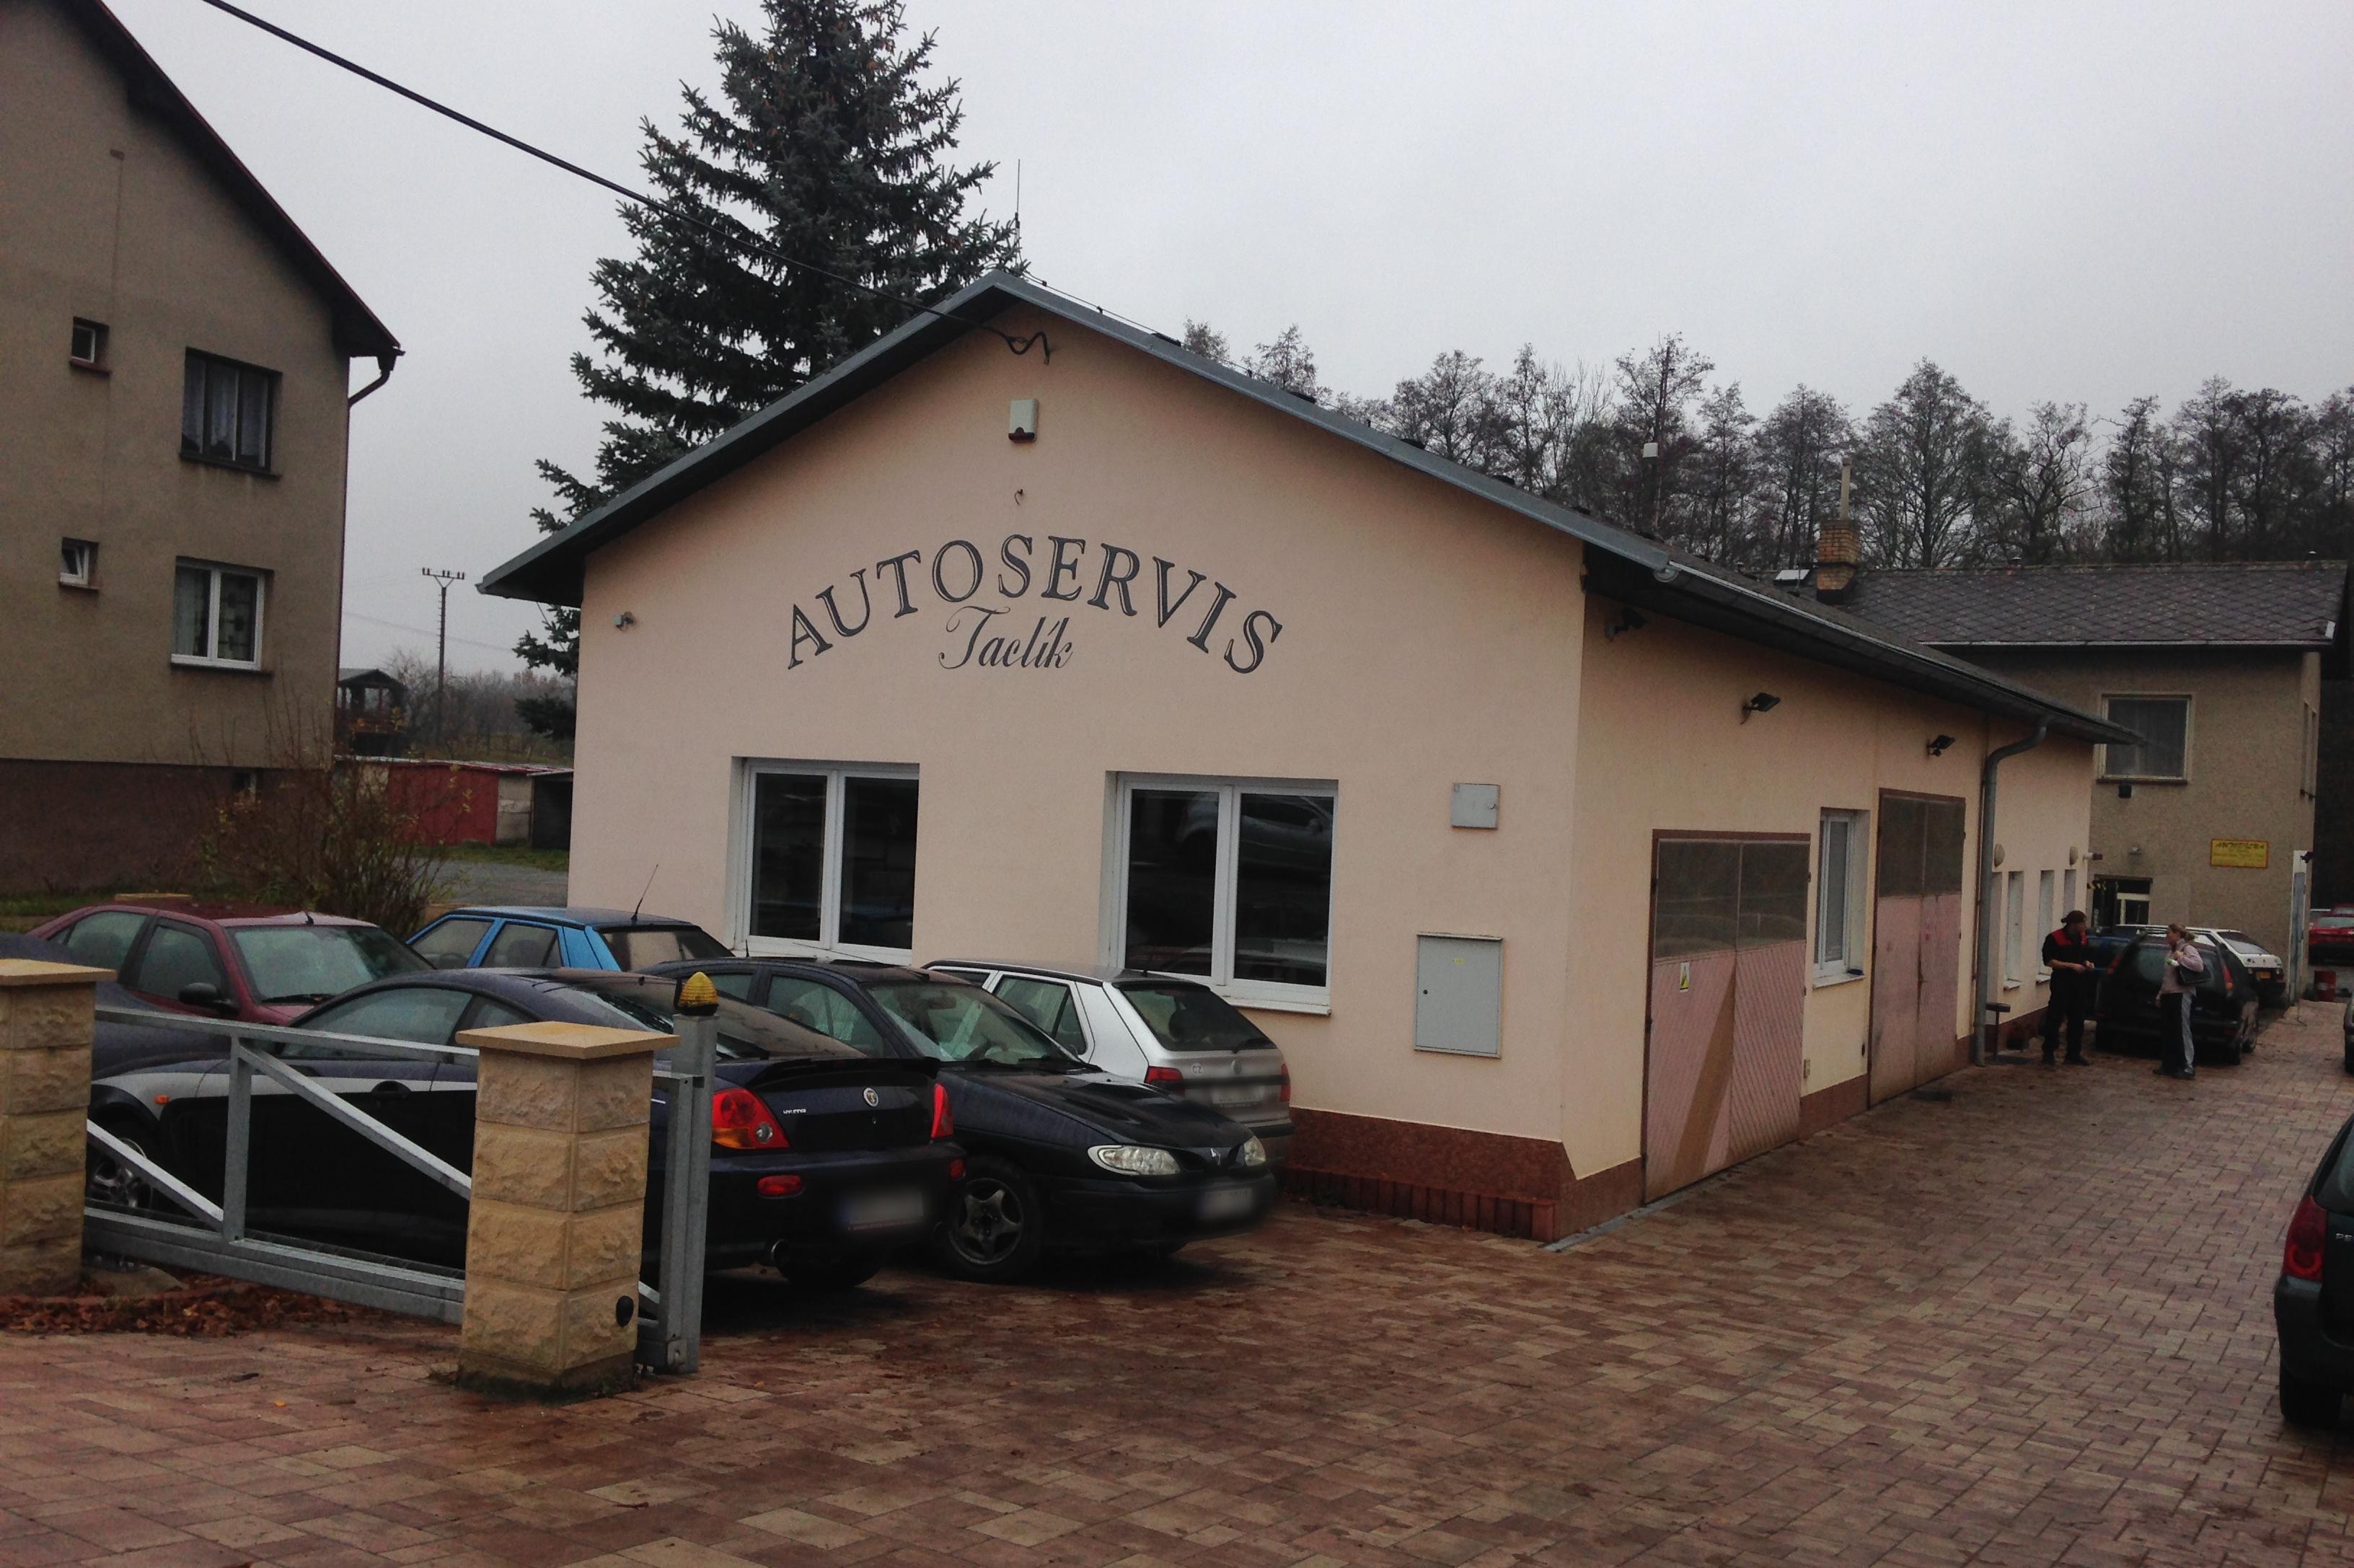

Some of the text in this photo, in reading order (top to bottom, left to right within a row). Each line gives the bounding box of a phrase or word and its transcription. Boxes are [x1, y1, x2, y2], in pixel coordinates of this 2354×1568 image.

[788, 534, 1283, 674] AUTOSERVIS
[938, 606, 1073, 669] Taclík
[1192, 1065, 1202, 1074] CZ
[2336, 1233, 2354, 1241] PE
